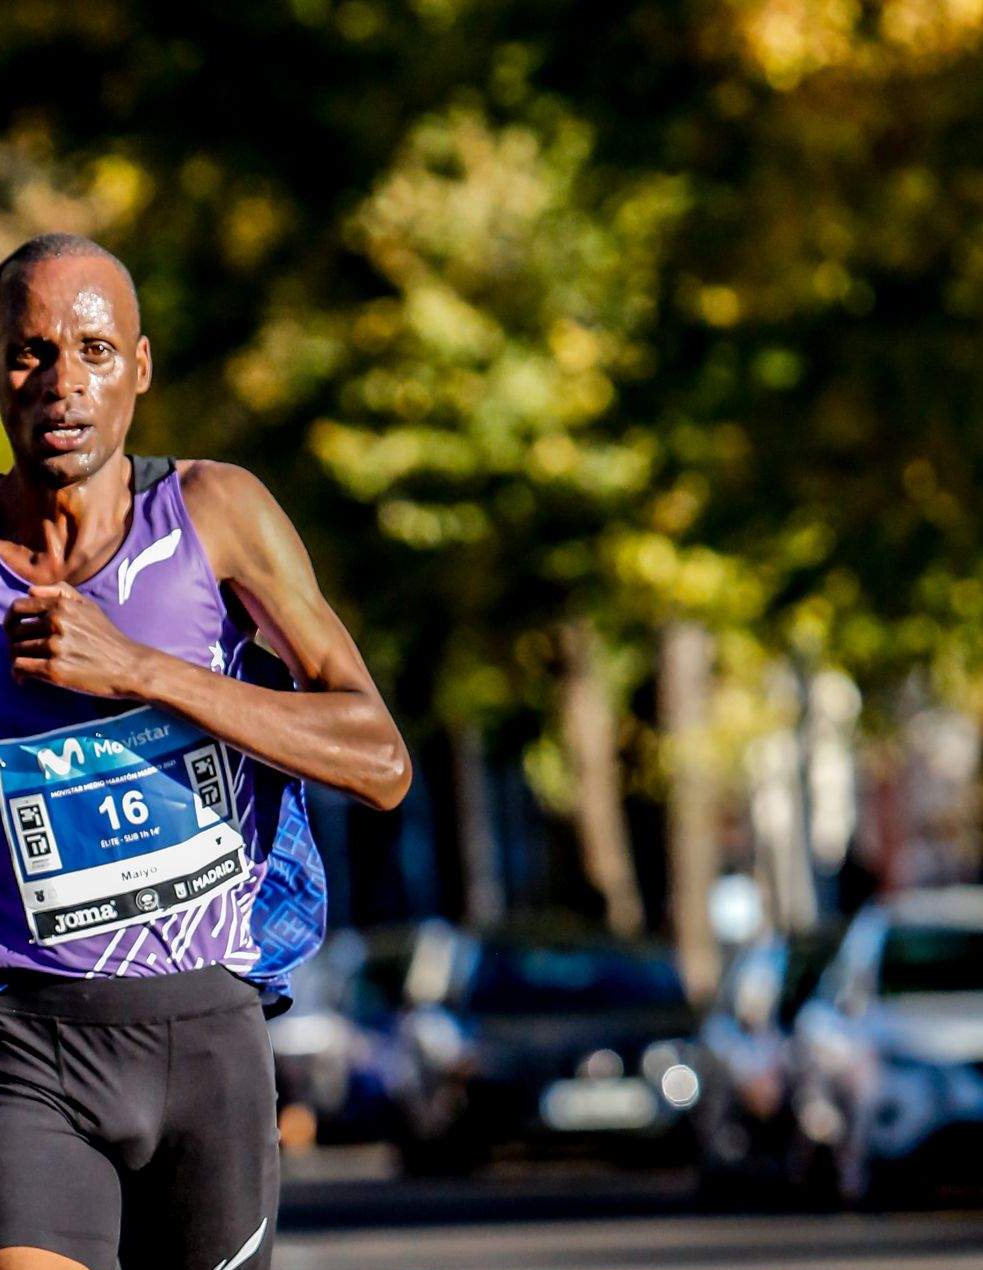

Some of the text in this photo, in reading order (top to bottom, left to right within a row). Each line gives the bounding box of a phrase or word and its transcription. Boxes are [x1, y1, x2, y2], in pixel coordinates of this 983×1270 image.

[93, 724, 170, 757] Movistar
[50, 785, 83, 799] MOVISTAR
[83, 780, 105, 792] MEDIO
[99, 790, 149, 830] 16
[192, 860, 235, 892] MADRID
